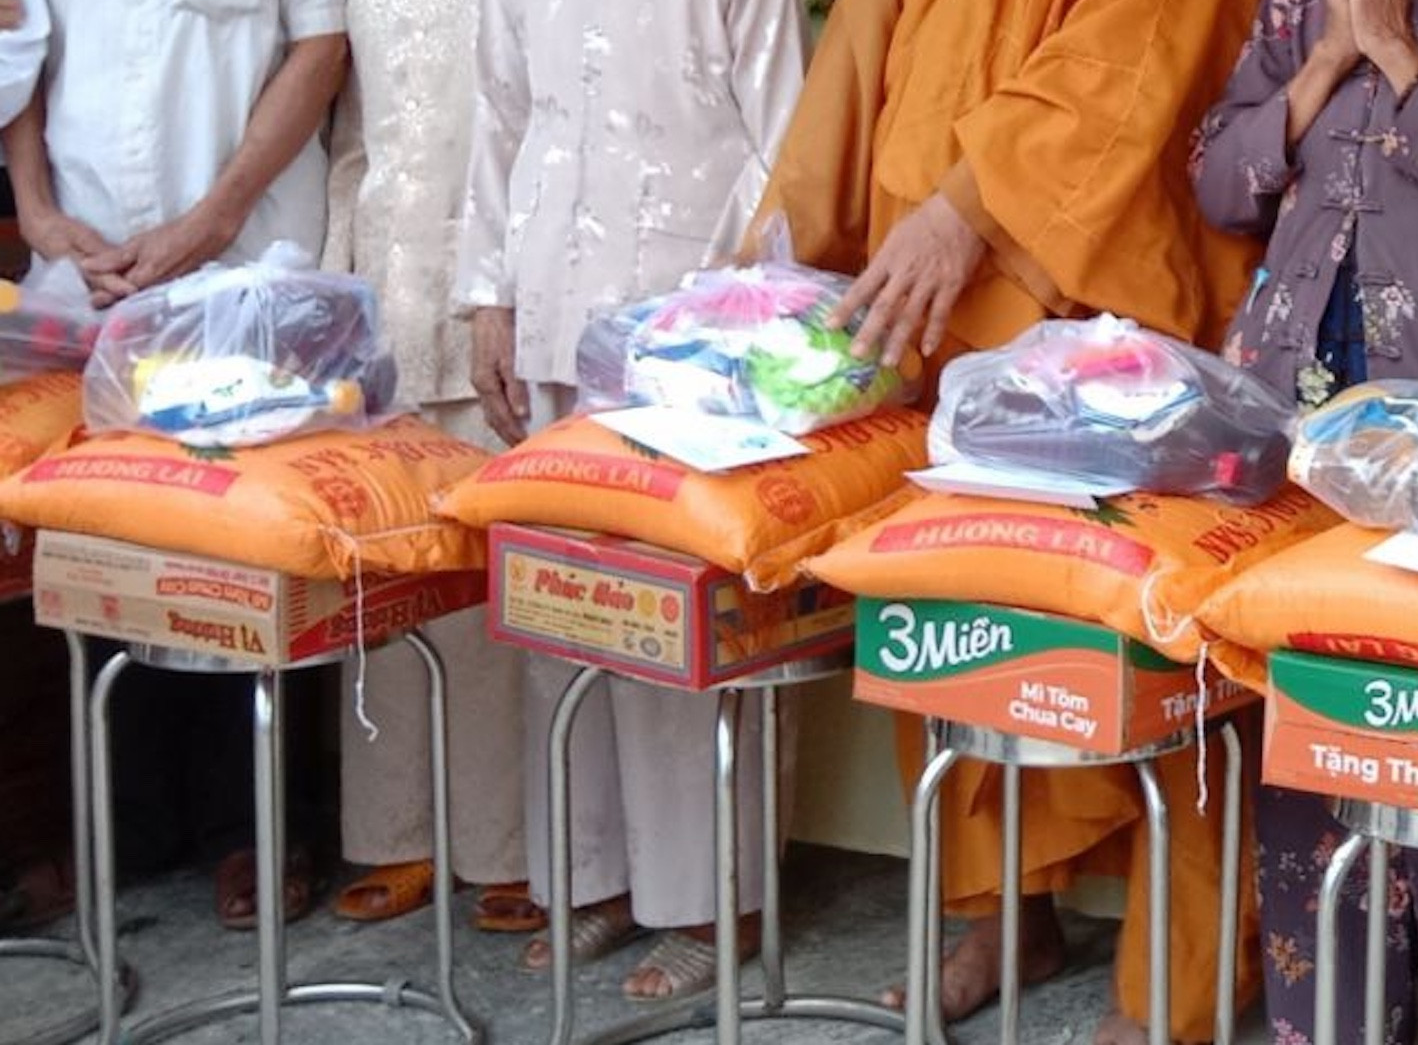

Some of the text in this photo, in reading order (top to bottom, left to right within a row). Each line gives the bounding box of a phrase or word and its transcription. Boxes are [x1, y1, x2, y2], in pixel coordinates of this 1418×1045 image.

[1008, 701, 1098, 739] Chua Cay
[1308, 743, 1380, 784] Tặng
